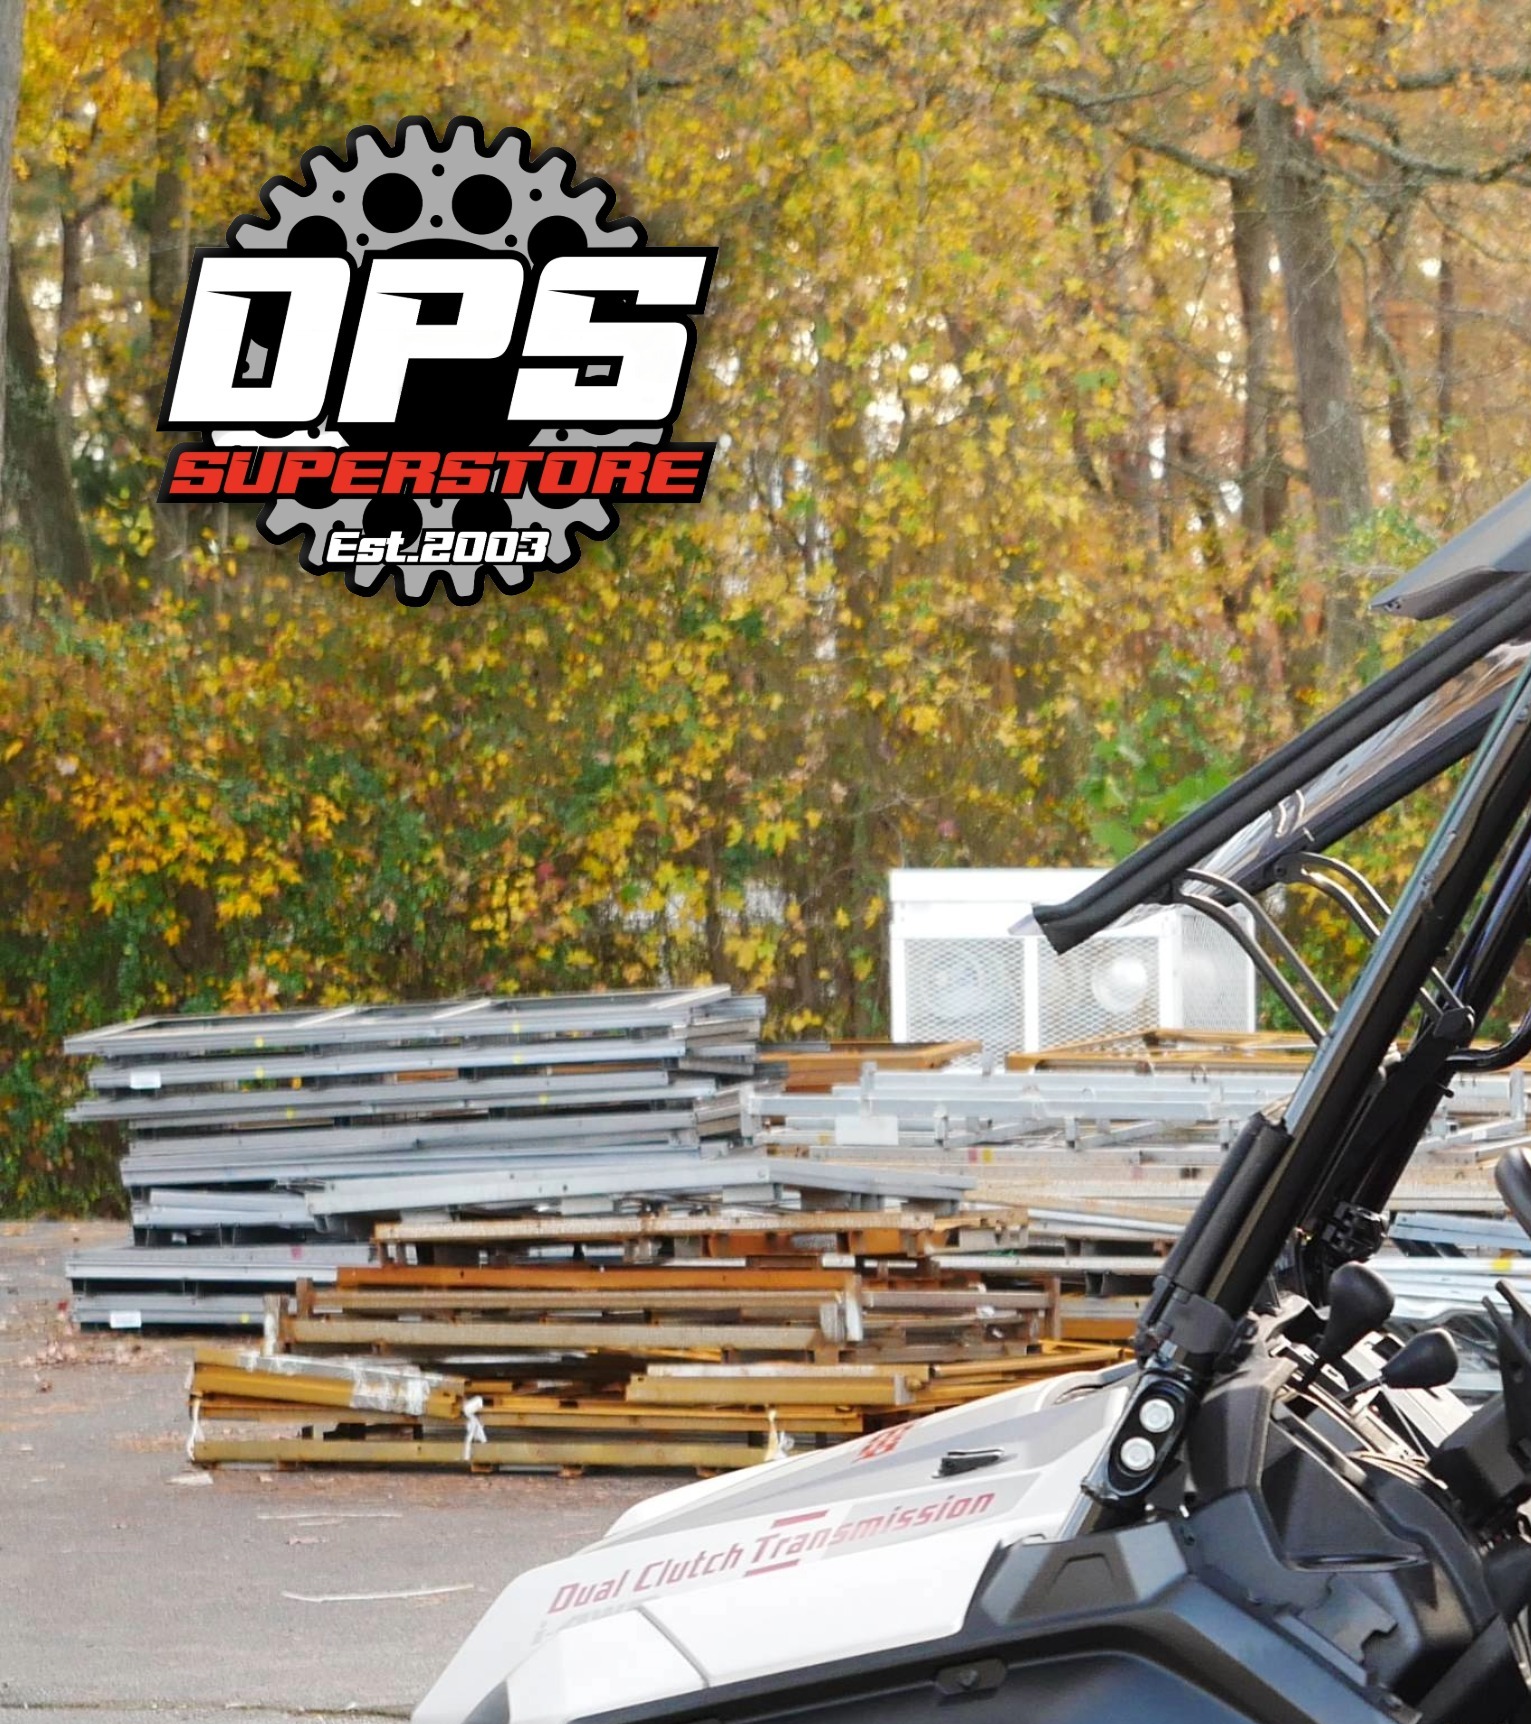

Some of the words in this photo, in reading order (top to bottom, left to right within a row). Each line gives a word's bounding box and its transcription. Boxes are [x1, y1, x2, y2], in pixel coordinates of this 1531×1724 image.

[550, 1569, 629, 1614] Dual
[632, 1542, 744, 1593] Clutch
[750, 1492, 996, 1564] Transmission
